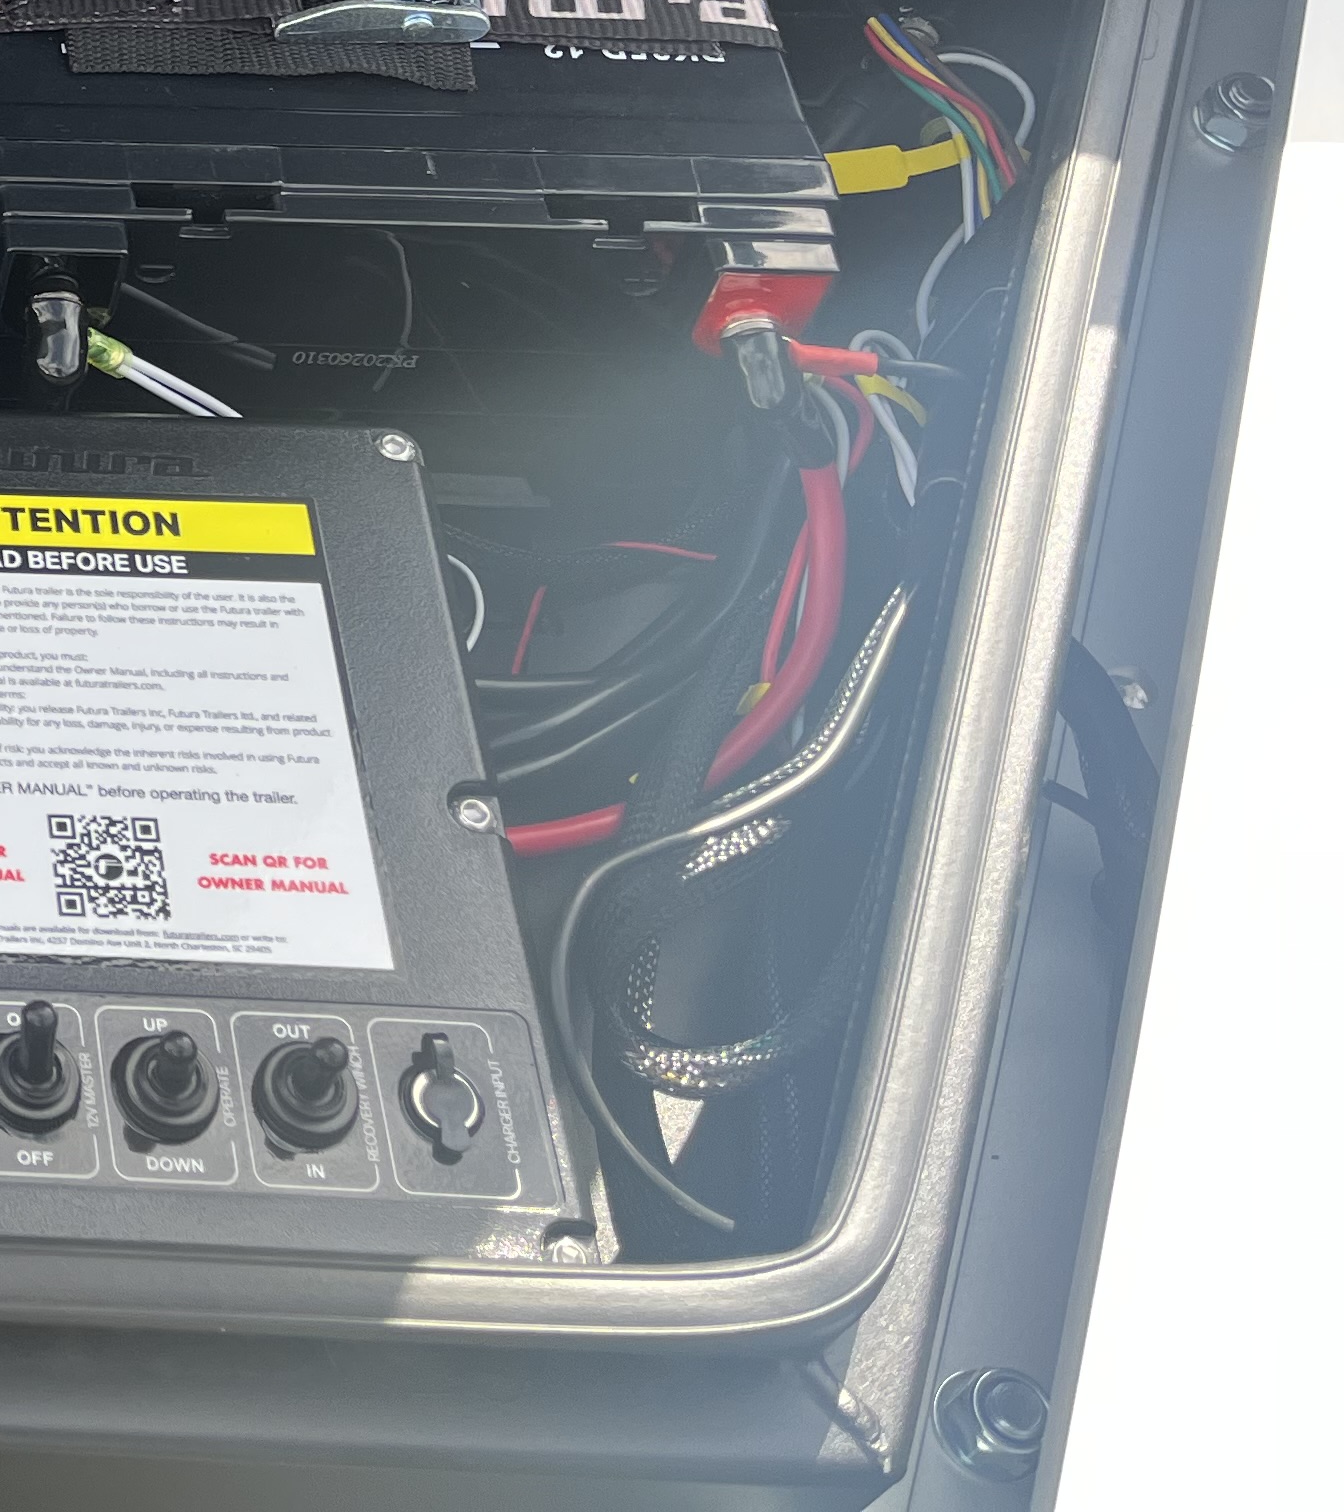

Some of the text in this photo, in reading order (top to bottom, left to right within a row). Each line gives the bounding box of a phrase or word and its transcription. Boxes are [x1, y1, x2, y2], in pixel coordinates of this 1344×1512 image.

[28, 550, 130, 574] BEFORE
[135, 552, 188, 575] USE
[96, 784, 146, 798] before
[148, 788, 221, 804] operating
[224, 789, 249, 802] the
[252, 790, 296, 804] trailer.
[208, 852, 329, 871] SCAN QR FOR
[197, 876, 350, 895] OWNER MANUAL
[143, 1017, 169, 1032] UP
[272, 1023, 311, 1040] OUT
[78, 1051, 98, 1108] MASTER
[216, 1065, 238, 1128] OPERATE
[347, 1044, 382, 1163] RECOVERY WINCH
[487, 1058, 522, 1165] CHARGER INPUT
[16, 1149, 55, 1167] OFF
[145, 1155, 207, 1174] DOWN
[305, 1163, 326, 1180] IN
